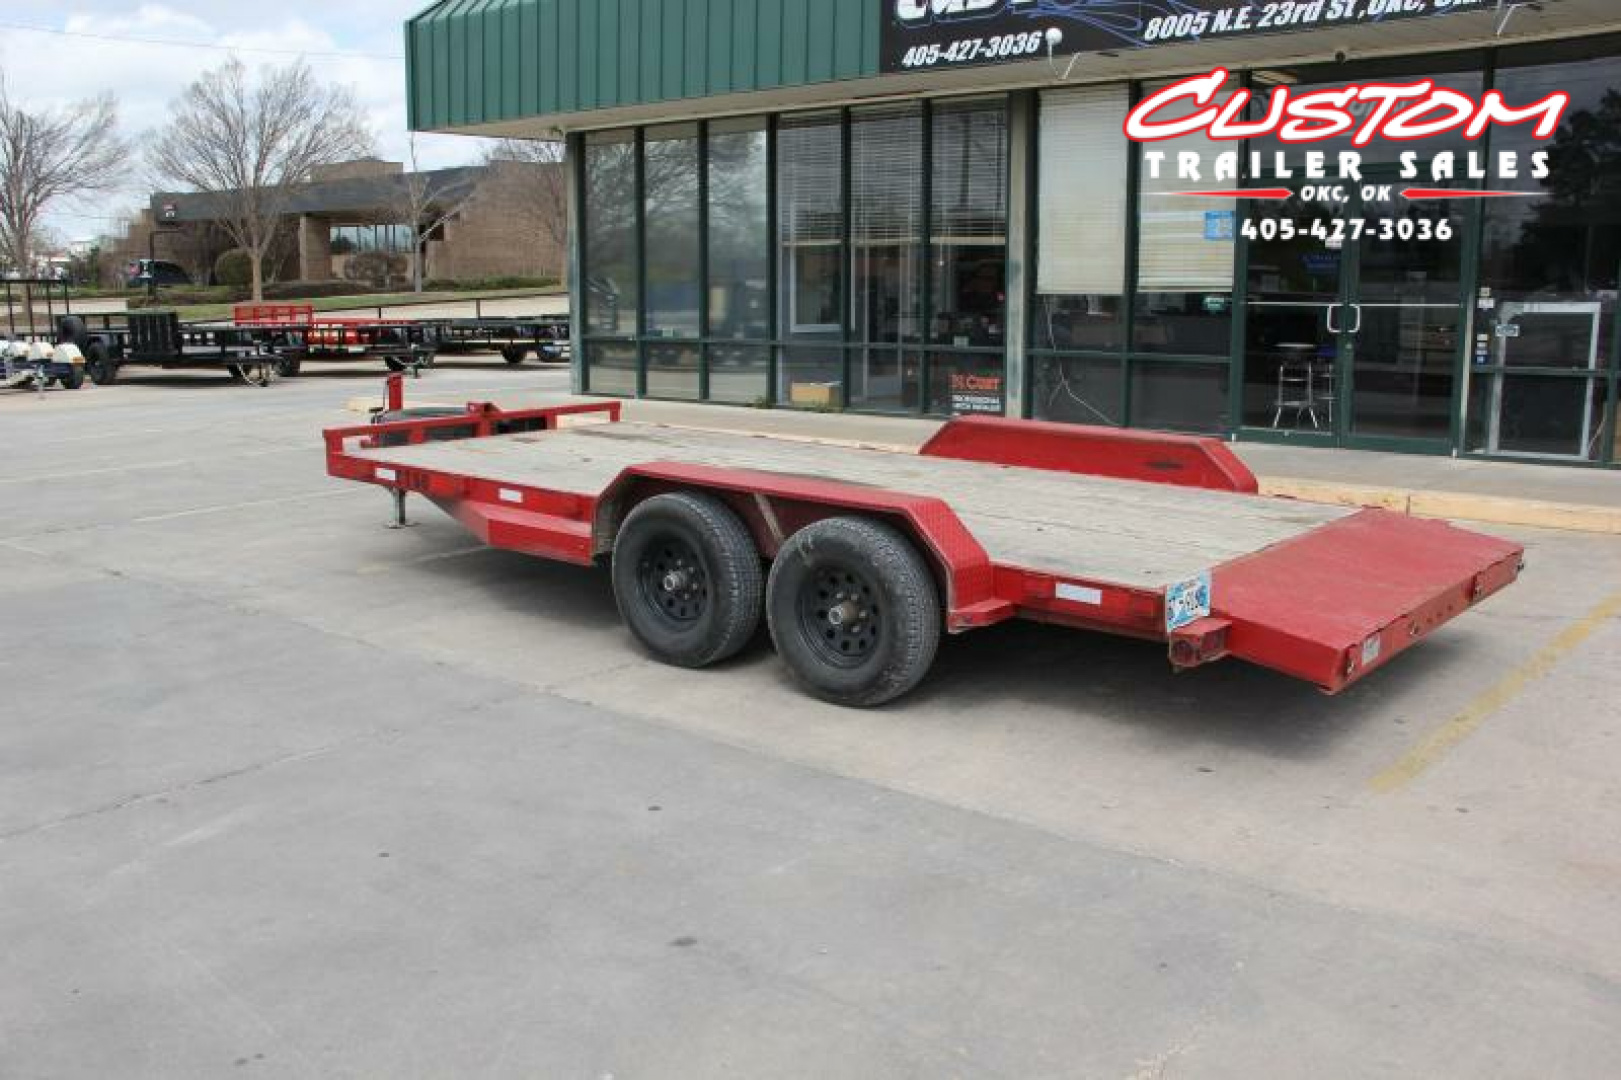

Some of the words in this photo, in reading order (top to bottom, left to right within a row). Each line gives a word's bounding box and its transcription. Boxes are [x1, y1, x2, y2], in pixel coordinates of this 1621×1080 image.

[1144, 11, 1211, 42] 8005
[1256, 0, 1326, 27] 23rd
[902, 31, 1042, 67] 405-427-3036
